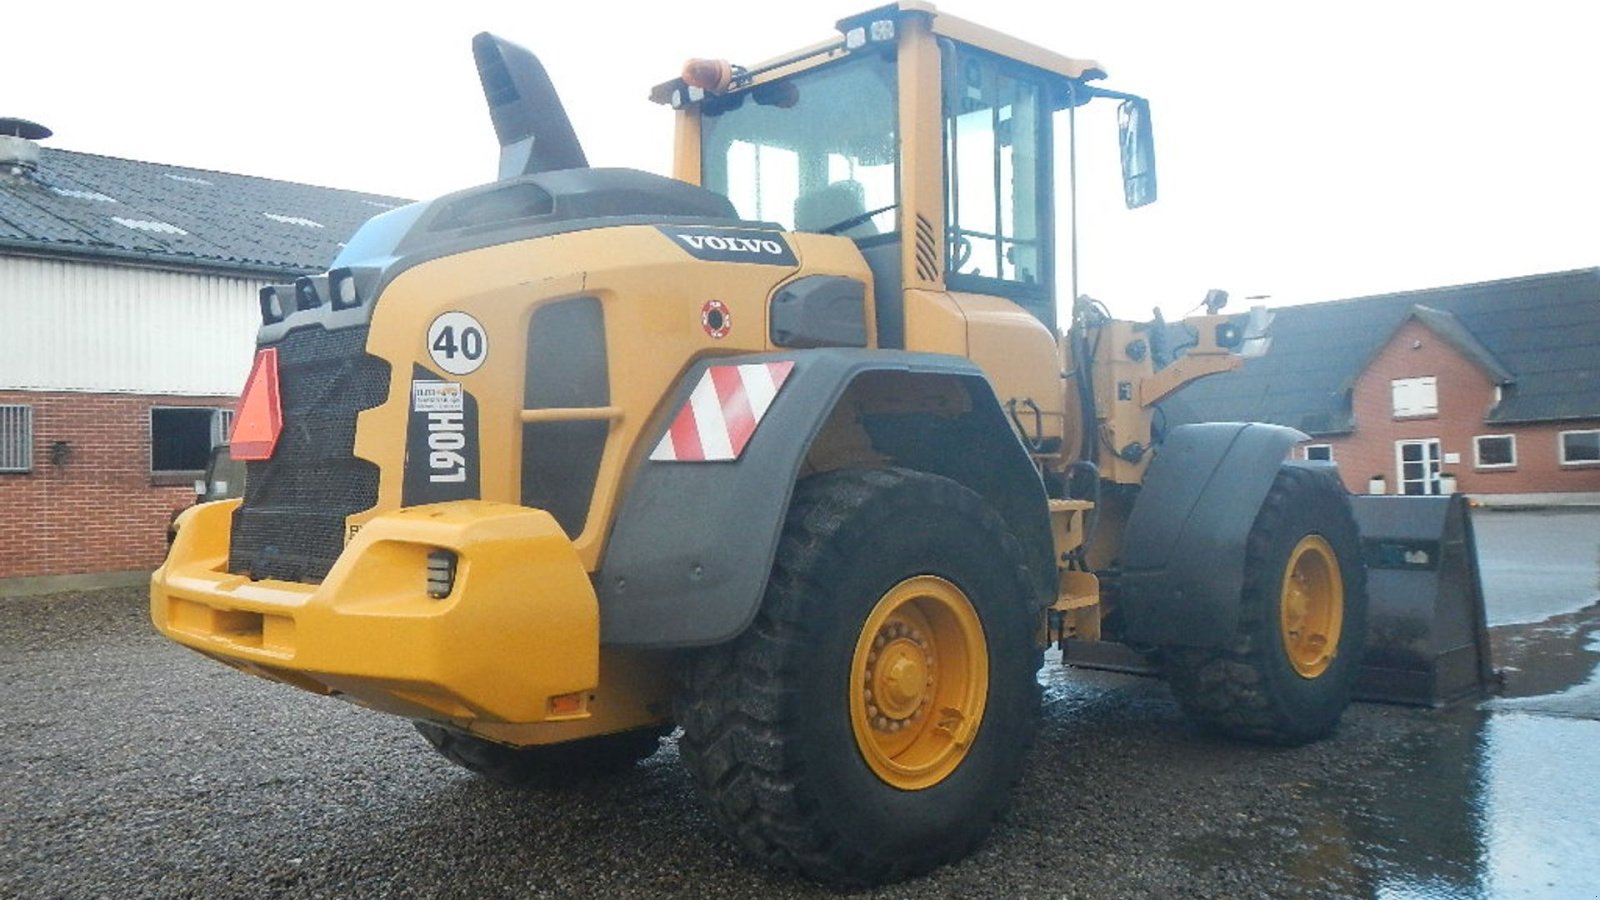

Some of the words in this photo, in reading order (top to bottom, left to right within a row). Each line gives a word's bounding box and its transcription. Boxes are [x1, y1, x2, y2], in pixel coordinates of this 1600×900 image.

[677, 234, 783, 254] VOLVO
[433, 325, 482, 361] 40
[428, 412, 466, 482] L90H
